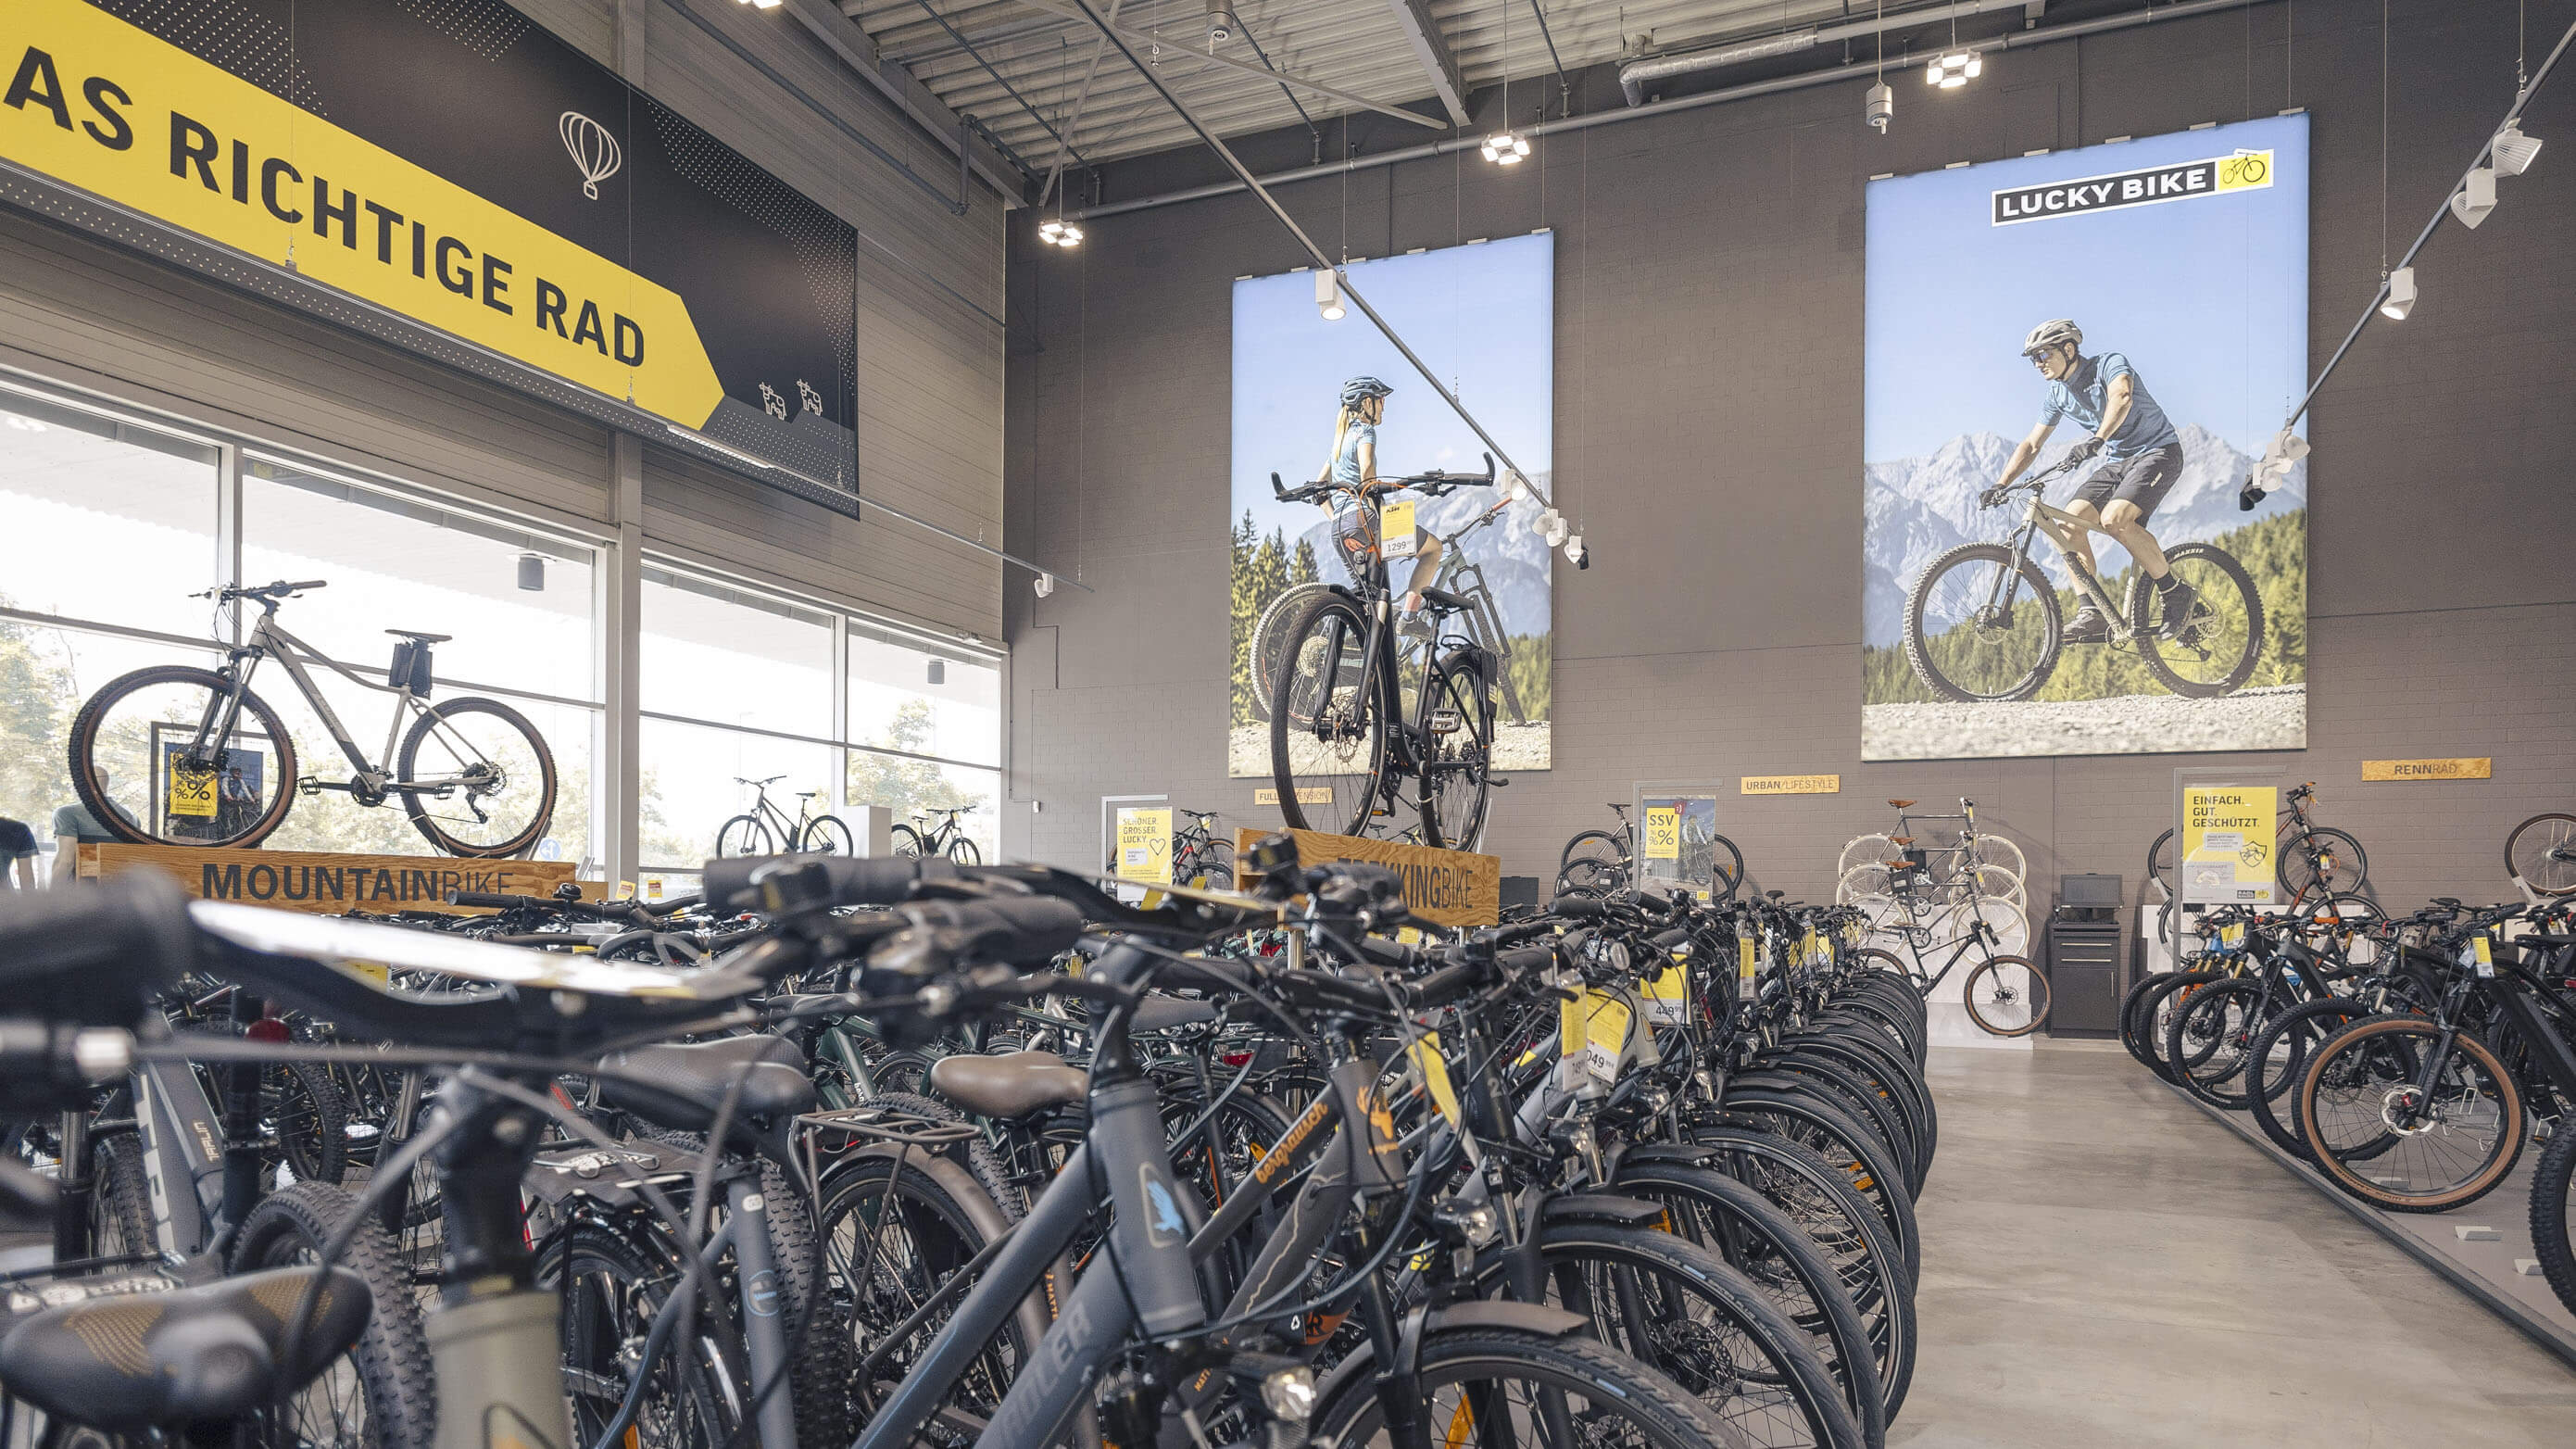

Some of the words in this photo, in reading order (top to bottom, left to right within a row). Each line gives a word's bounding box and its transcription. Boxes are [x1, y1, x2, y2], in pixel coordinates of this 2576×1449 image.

[2002, 182, 2115, 218] LUCKY
[2122, 168, 2207, 201] BIKE
[170, 109, 513, 317] RICHTIGE
[535, 276, 645, 368] RAD
[1388, 541, 1406, 551] 1299
[2394, 763, 2458, 775] RENNRAD
[1650, 814, 1674, 826] SSV
[203, 863, 514, 902] MOUNTAINBIKE
[1338, 858, 1473, 909] KINGBIKE
[1586, 1049, 1604, 1068] 049
[1255, 1102, 1328, 1184] bergrausch
